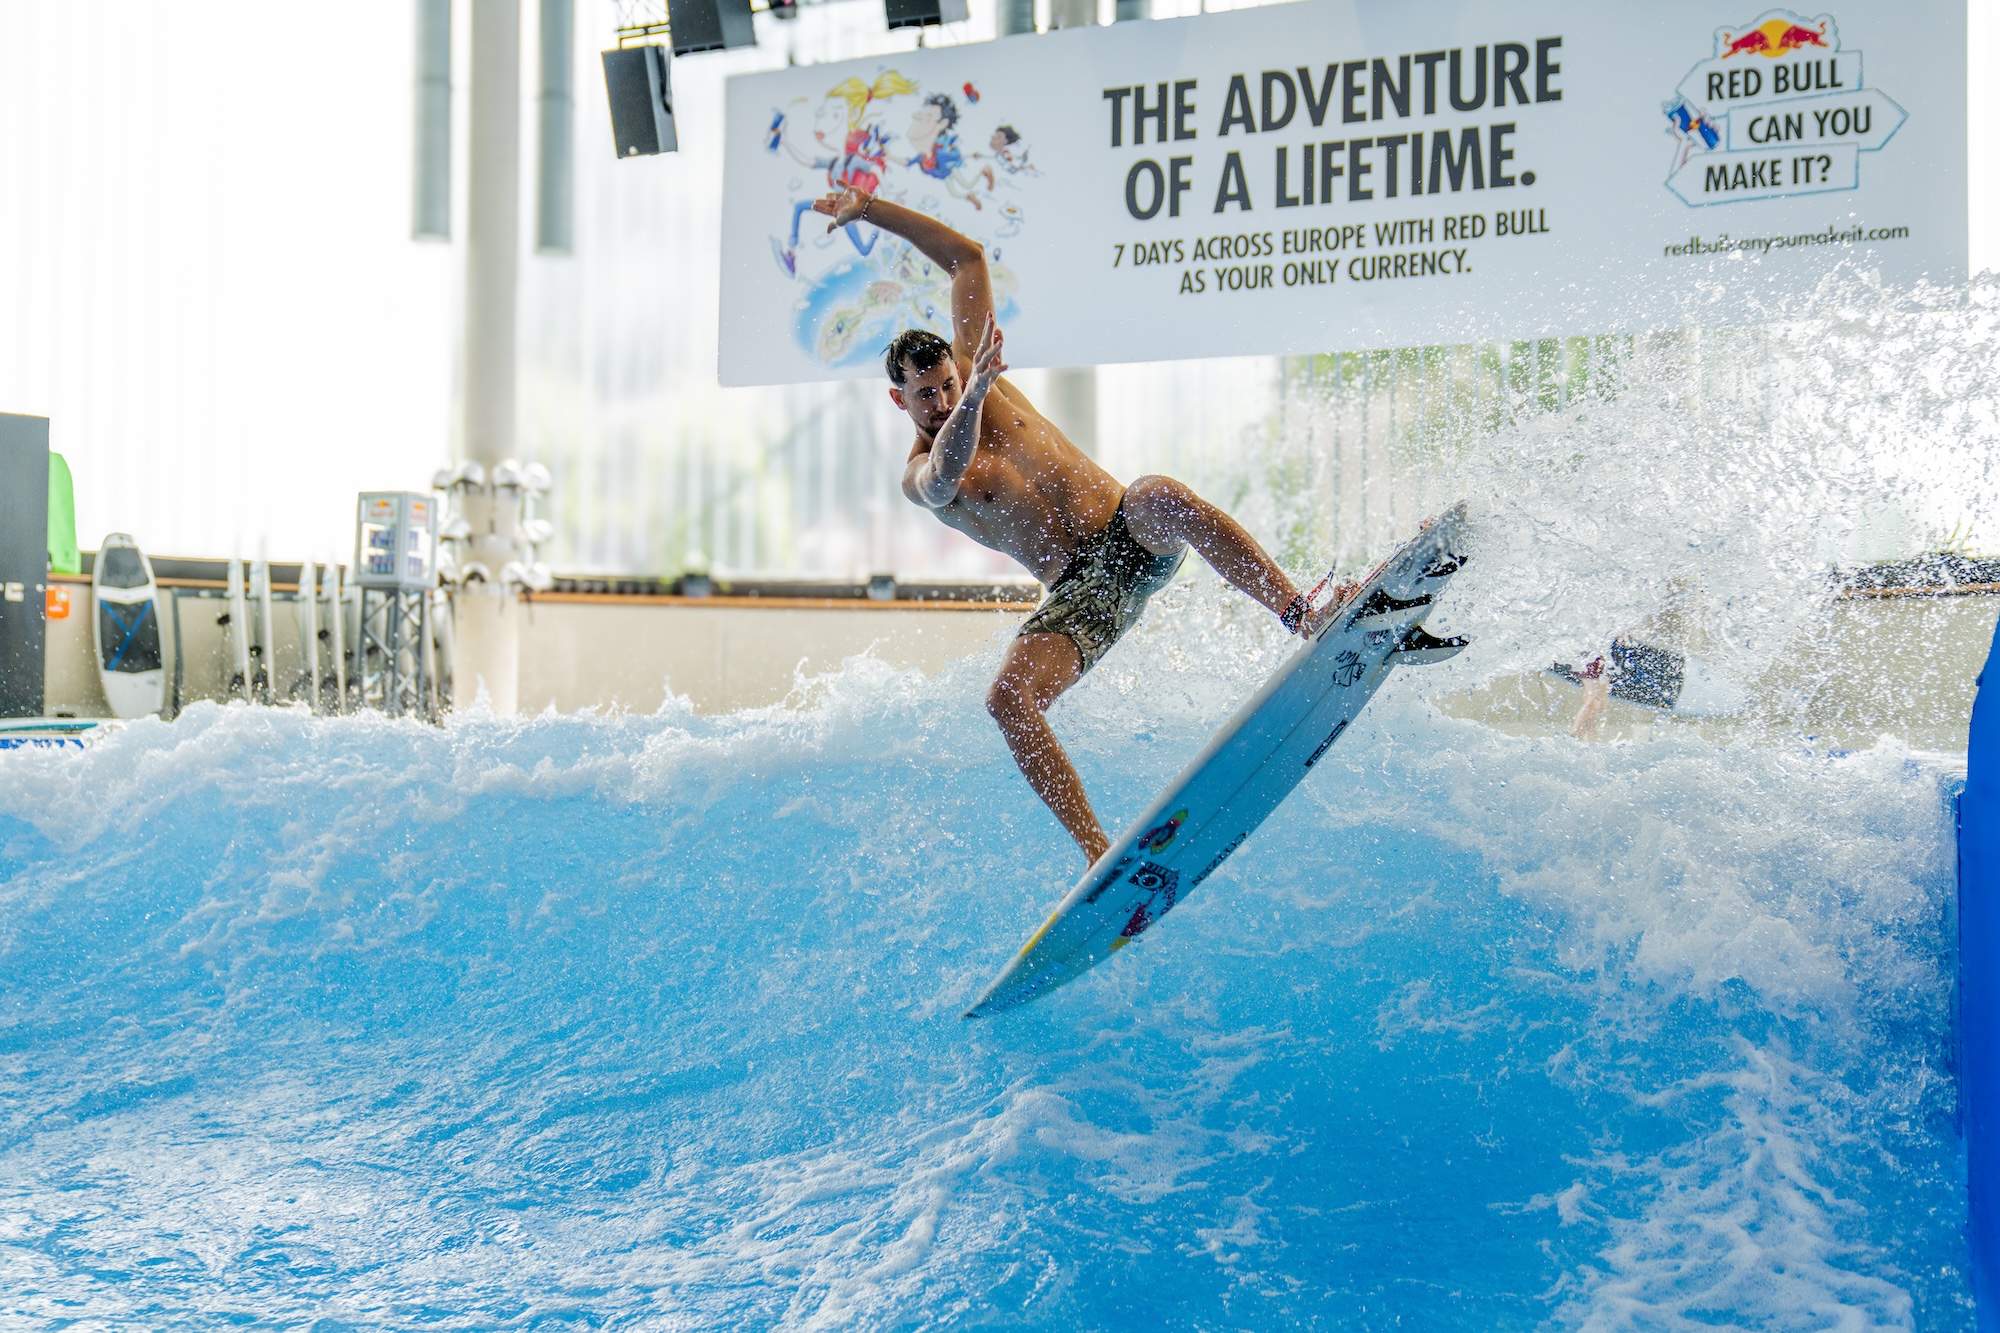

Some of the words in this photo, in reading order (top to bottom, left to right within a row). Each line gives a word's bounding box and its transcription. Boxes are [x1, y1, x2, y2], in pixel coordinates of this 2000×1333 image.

[1103, 79, 1198, 148] THE
[1218, 36, 1563, 137] ADVENTURE
[1707, 68, 1762, 101] RED
[1774, 58, 1843, 94] BULL
[1748, 112, 1803, 144] CAN
[1813, 105, 1872, 138] YOU
[1125, 156, 1193, 221] OF
[1213, 152, 1253, 214] A
[1276, 123, 1537, 208] LIFETIME.
[1704, 159, 1782, 193] MAKE
[1793, 154, 1833, 185] IT?
[1113, 243, 1126, 268] 7
[1133, 239, 1185, 266] DAYS
[1192, 232, 1275, 262] ACROSS
[1283, 224, 1366, 255] EUROPE
[1374, 218, 1435, 247] WITH
[1443, 214, 1487, 241] RED
[1496, 208, 1550, 237] BULL
[1180, 269, 1207, 295] AS
[1214, 265, 1274, 292] YOUR
[1282, 259, 1341, 287] ONLY
[1348, 248, 1473, 282] CURRENCY.
